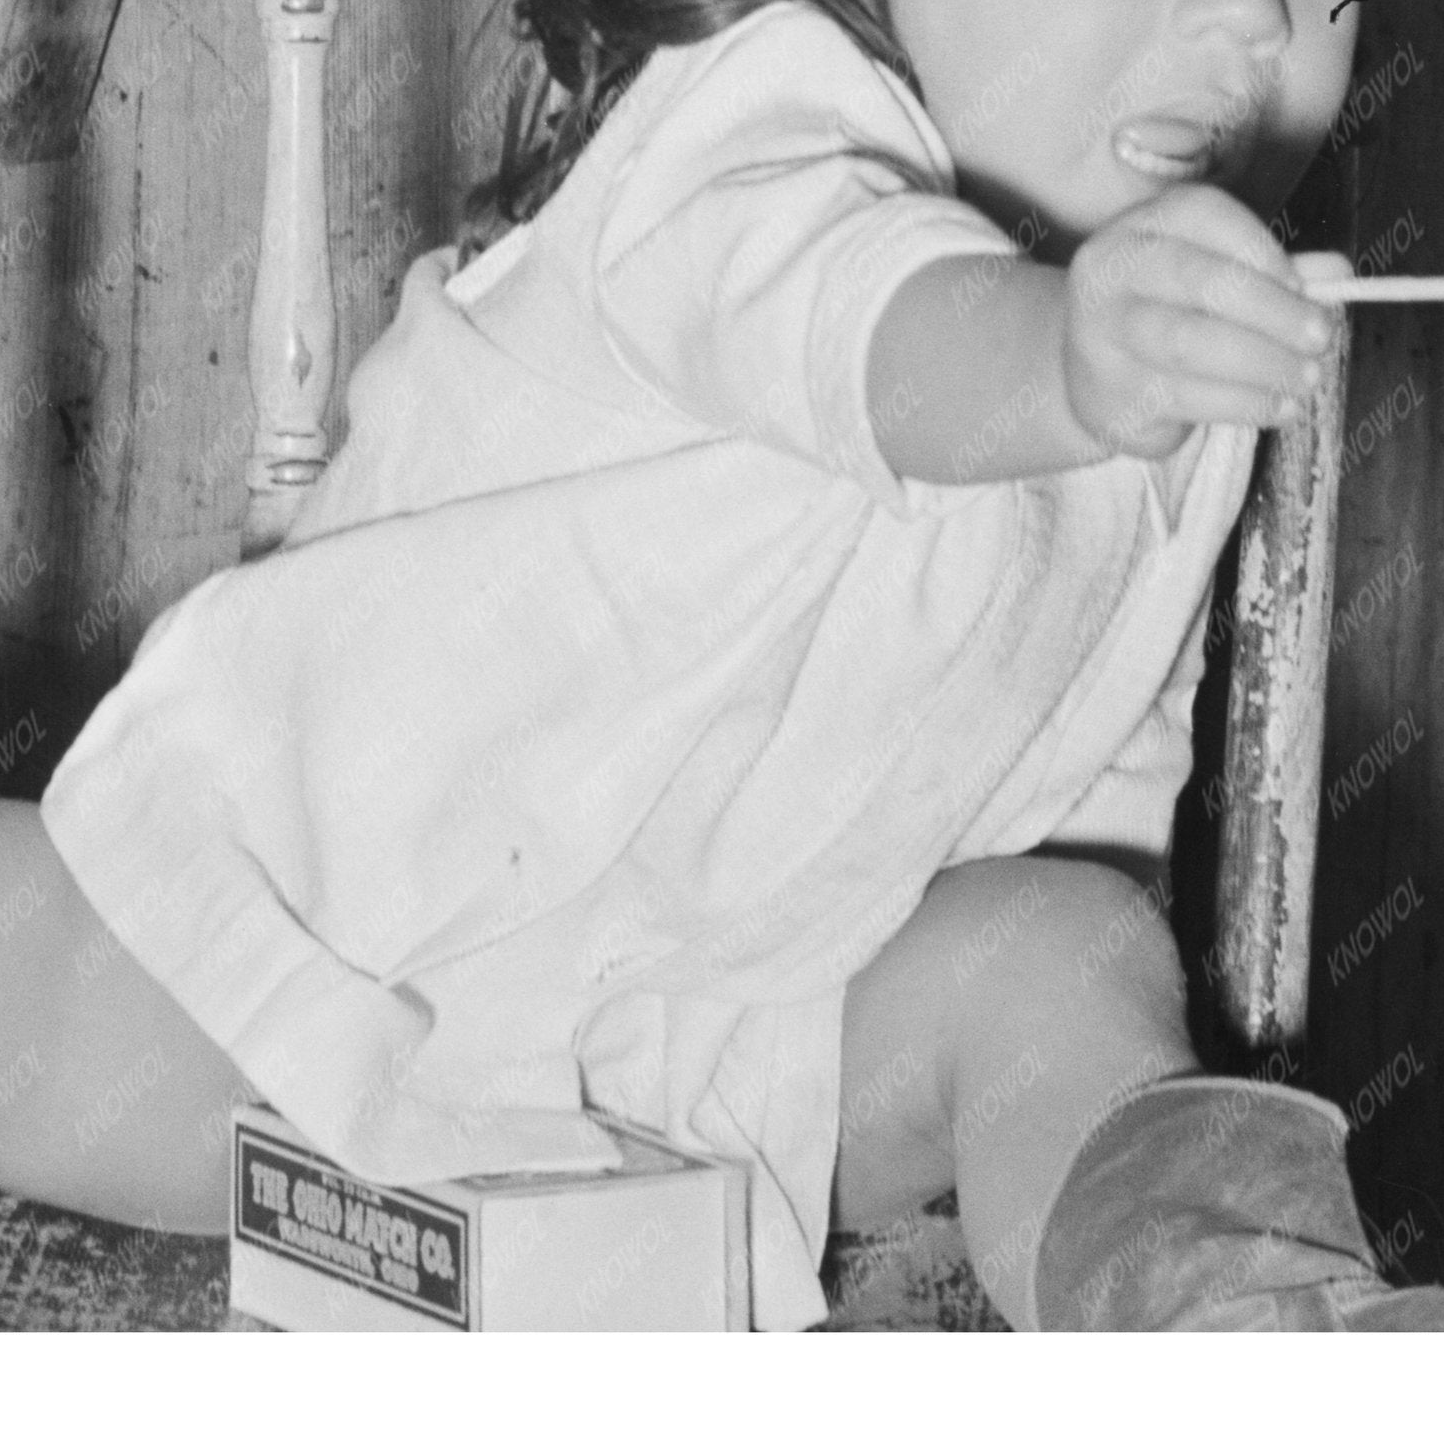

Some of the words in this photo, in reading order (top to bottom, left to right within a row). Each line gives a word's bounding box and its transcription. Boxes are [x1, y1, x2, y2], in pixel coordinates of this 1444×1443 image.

[250, 1160, 290, 1216] THE
[292, 1178, 343, 1236] OHIO
[345, 1197, 418, 1268] MATCH
